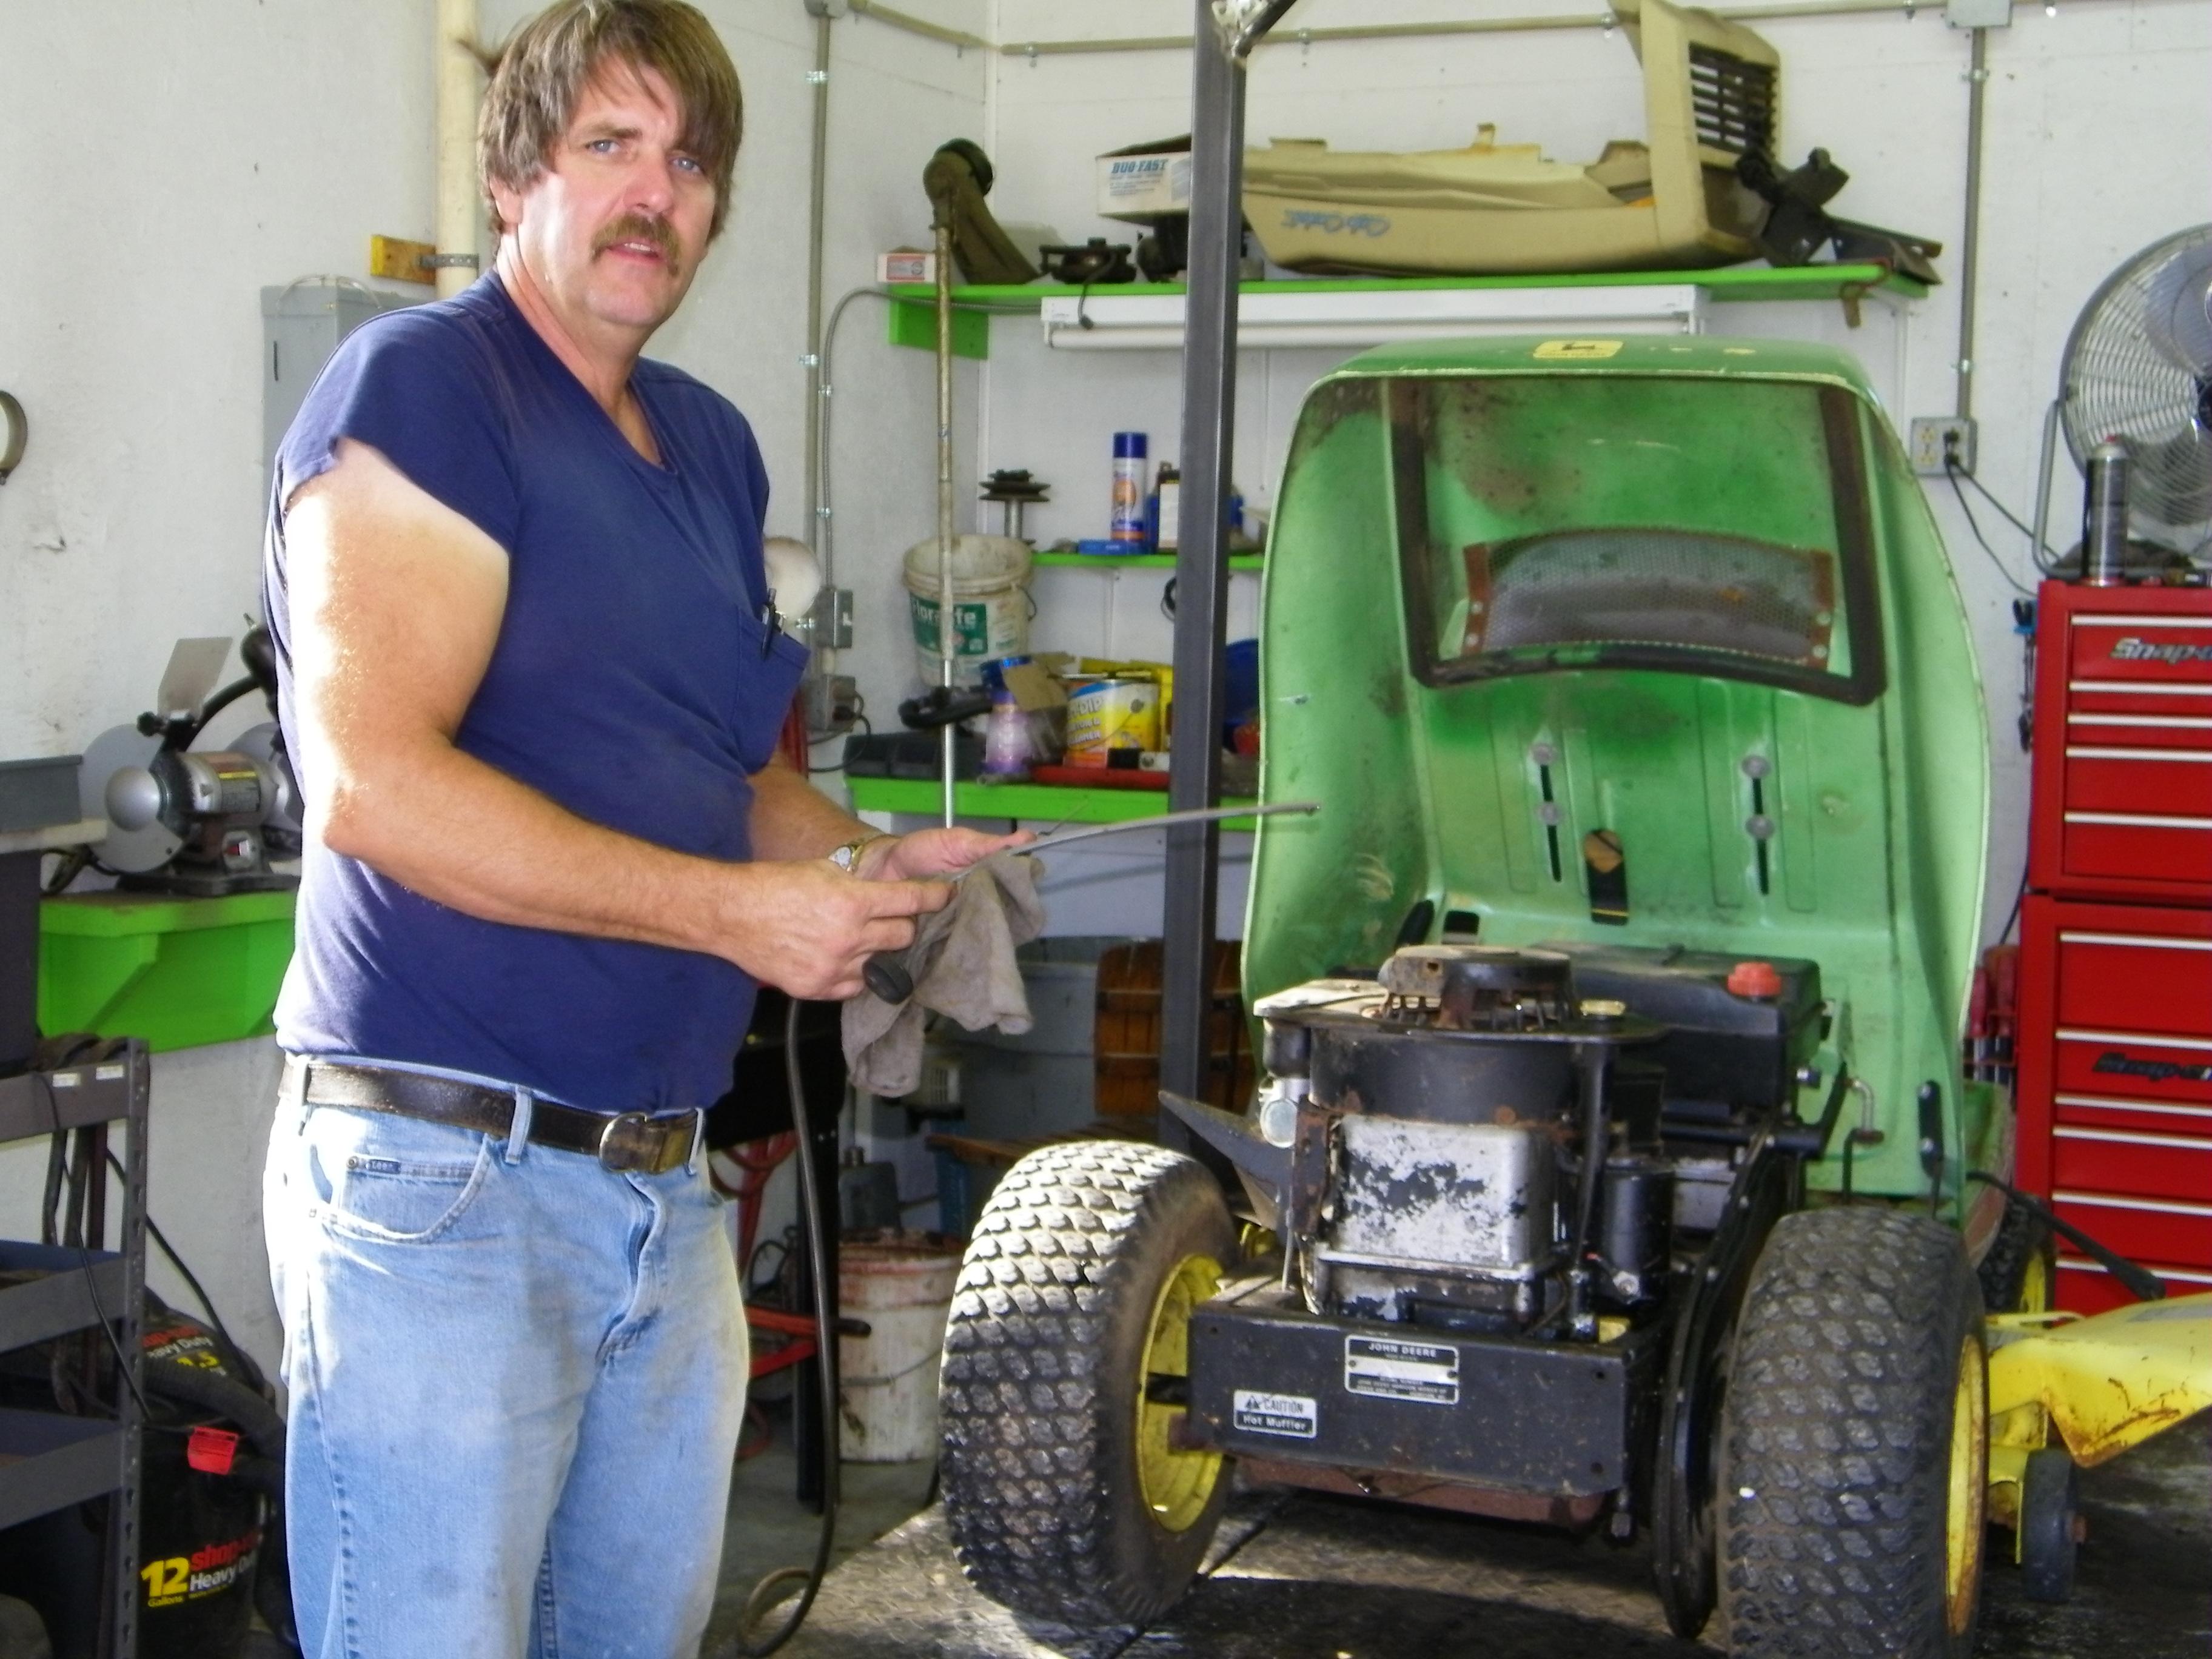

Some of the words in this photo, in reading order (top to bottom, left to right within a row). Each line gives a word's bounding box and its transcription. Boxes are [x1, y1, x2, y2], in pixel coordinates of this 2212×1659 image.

[1368, 1342, 1398, 1353] JOHN
[1401, 1346, 1437, 1358] DEERE
[1263, 1398, 1304, 1413] CAUTION
[1243, 1413, 1262, 1426] Hot
[140, 1557, 190, 1598] 12
[189, 1565, 237, 1592] Heavy
